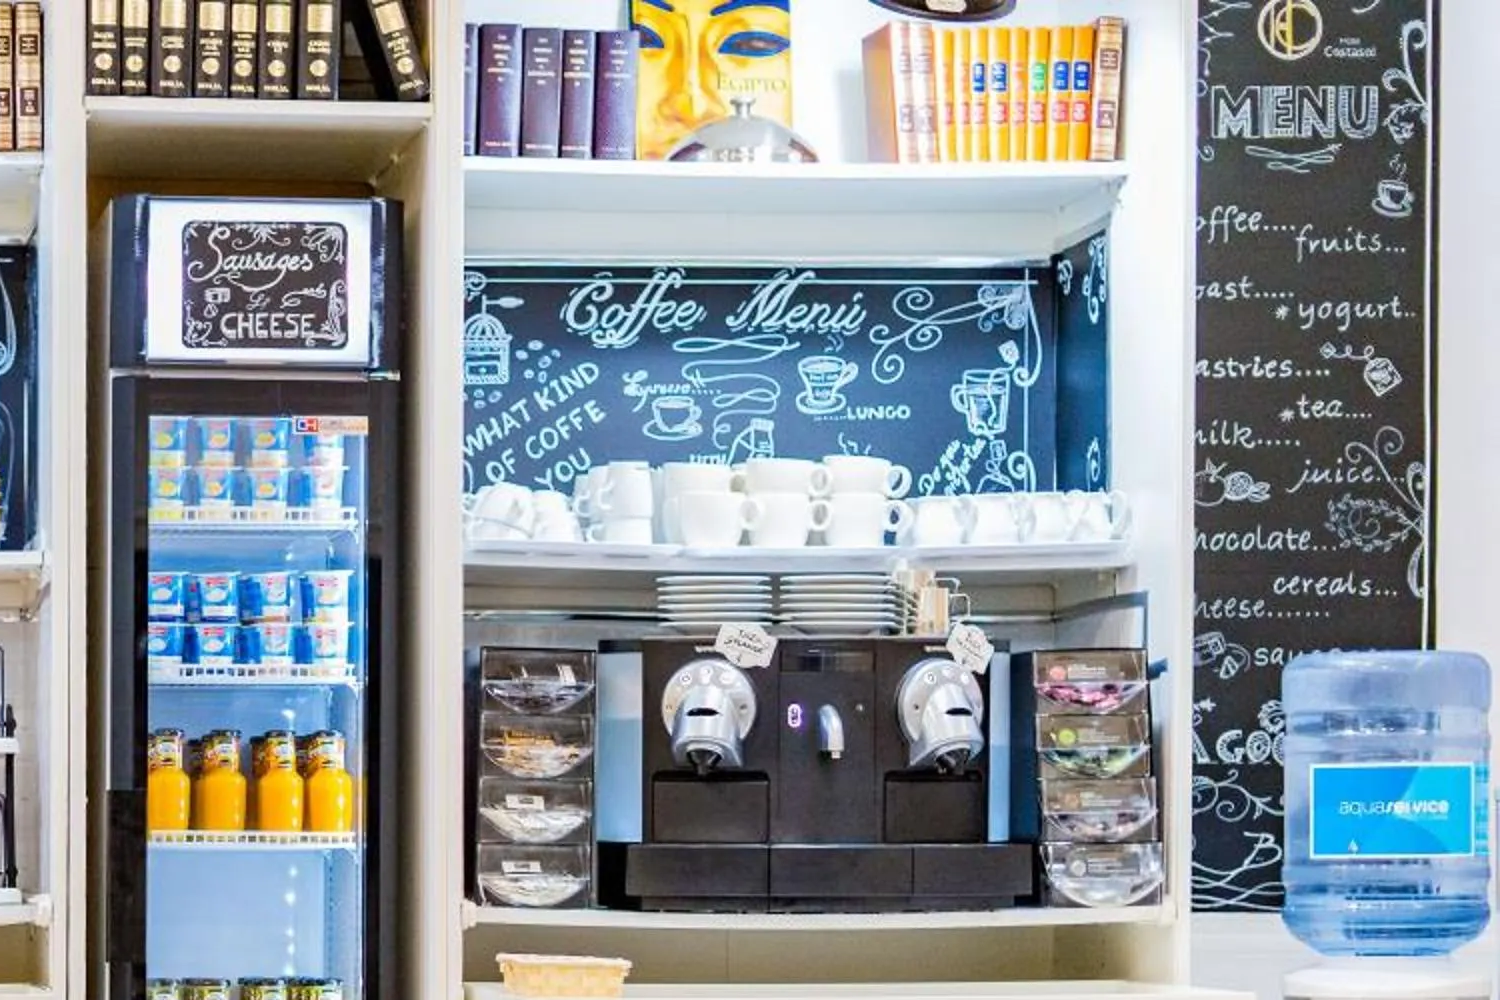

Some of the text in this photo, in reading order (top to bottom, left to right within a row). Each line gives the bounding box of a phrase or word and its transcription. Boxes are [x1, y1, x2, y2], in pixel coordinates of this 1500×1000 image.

[1211, 85, 1379, 139] MENU
[187, 226, 313, 292] Sausages
[220, 312, 317, 339] CHEESE
[564, 269, 702, 344] Coffee
[463, 363, 599, 457] WHAT KIND
[485, 400, 606, 484] OF COFFE
[534, 447, 592, 491] YOU
